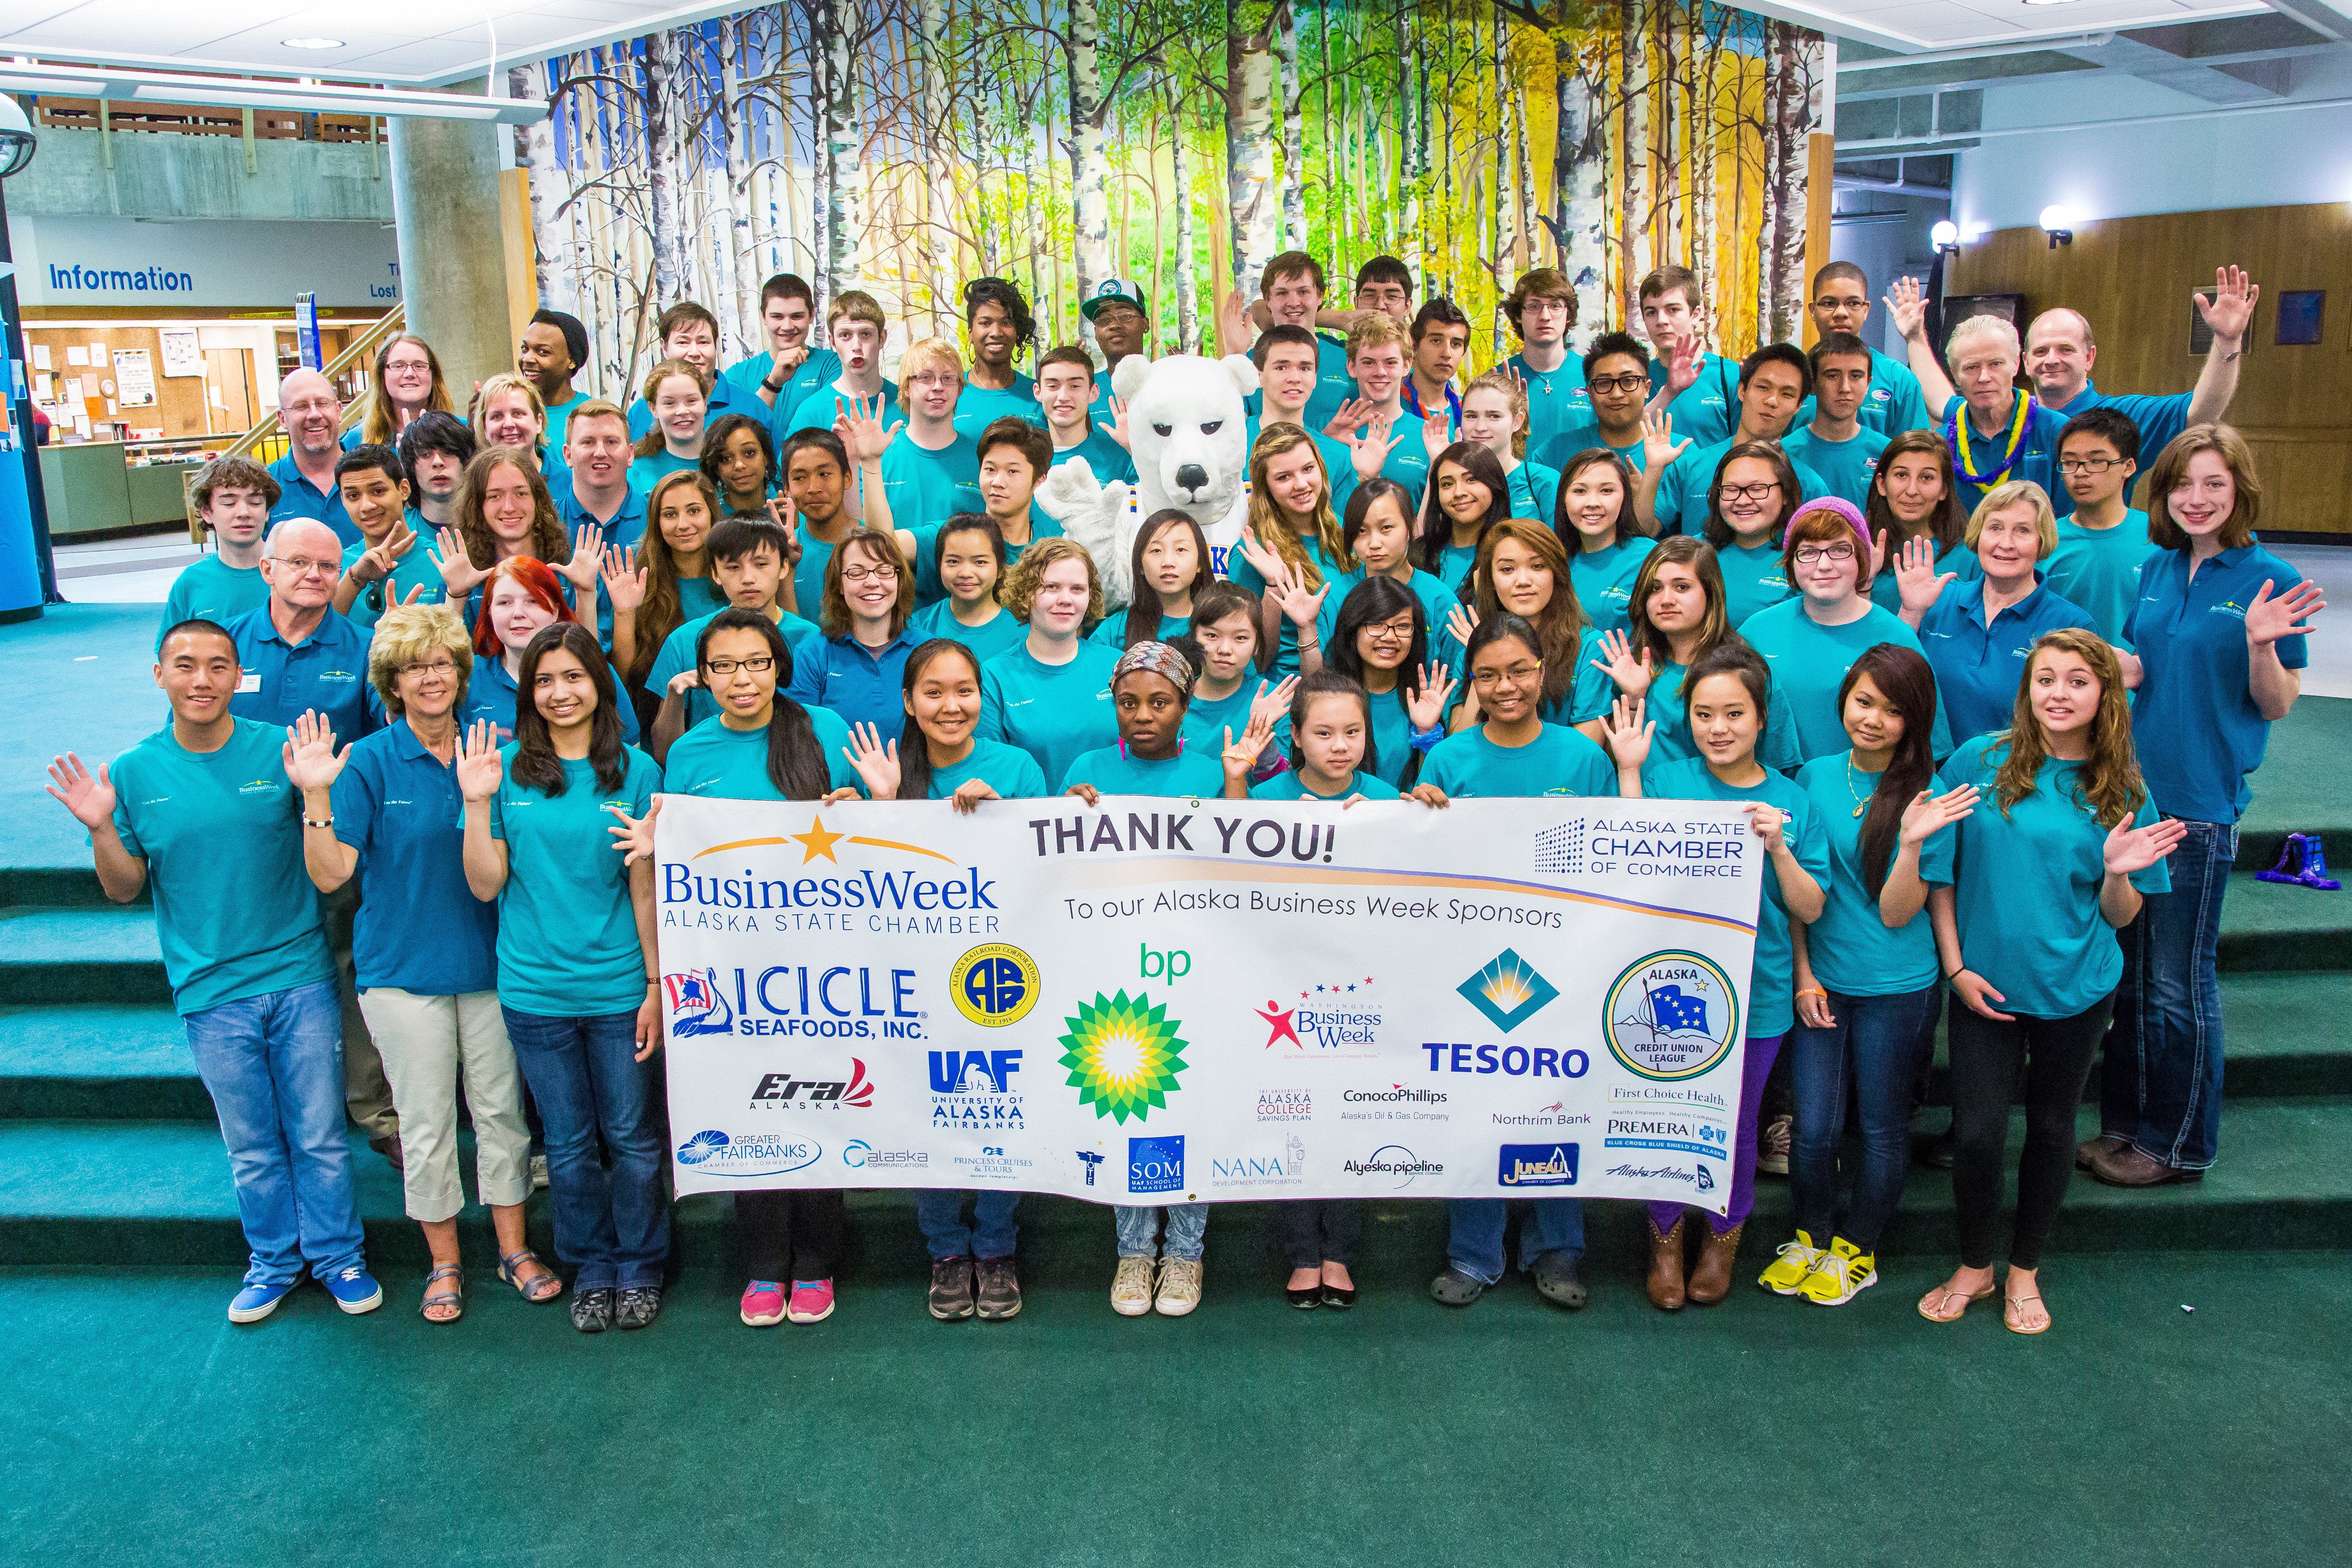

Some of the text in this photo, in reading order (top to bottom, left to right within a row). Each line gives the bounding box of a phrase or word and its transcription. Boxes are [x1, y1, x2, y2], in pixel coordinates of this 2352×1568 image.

[49, 264, 192, 291] Information
[370, 284, 397, 298] Lost
[239, 784, 280, 793] BusinessWeek
[1593, 820, 1744, 835] ALASKA STATE
[1029, 813, 1335, 863] THANK YOU!
[1592, 838, 1743, 859] CHAMBER
[1591, 861, 1741, 877] OF COMMERCE
[662, 864, 998, 909] BusinessWeek
[1064, 889, 1562, 928] To our Alaska Business Week Sponsors
[665, 910, 999, 933] ALASKA STATE CHAMBER
[953, 946, 1037, 987] ALASKA RAILROAD CORPORATION
[1141, 943, 1191, 986] bp
[1649, 969, 1698, 980] ALASKA
[734, 966, 919, 1018] ICICLE
[1296, 1009, 1382, 1033] Business
[740, 1019, 928, 1040] SEAFOODS, INC.
[1316, 1026, 1375, 1049] Week
[1634, 1044, 1703, 1053] CREDIT UNION
[1422, 1043, 1589, 1078] TESORO
[1649, 1054, 1686, 1063] LEAGUE
[928, 1049, 1023, 1094] UAF
[751, 1073, 848, 1100] Era
[932, 1096, 1002, 1104] UNIVERSITY
[1259, 1093, 1311, 1104] ALASKA
[1343, 1089, 1448, 1105] ConocoPhillips
[1615, 1088, 1723, 1106] First Choice Health
[749, 1101, 841, 1111] ALASKA
[933, 1104, 1024, 1120] ALASKA
[1257, 1103, 1312, 1114] COLLEGE
[1414, 1112, 1449, 1121] Company
[1493, 1114, 1591, 1125] Northrim Bank
[1693, 1114, 1722, 1124] Companies.
[933, 1120, 1024, 1130] FAIRBANKS
[1608, 1120, 1688, 1135] PREMERA
[735, 1135, 780, 1145] GREATER
[721, 1144, 808, 1160] FAIRBANKS
[867, 1149, 928, 1163] alaska
[1702, 1147, 1725, 1158] ALASKA
[997, 1159, 1032, 1167] CRUISES
[1131, 1160, 1182, 1179] SOM
[1212, 1157, 1283, 1178] NANA
[1343, 1159, 1444, 1176] Alyeska pipeline
[1504, 1159, 1564, 1183] JUNEAU
[1605, 1164, 1695, 1183] Alaska Airlines
[1131, 1183, 1181, 1191] MANAGEMENT
